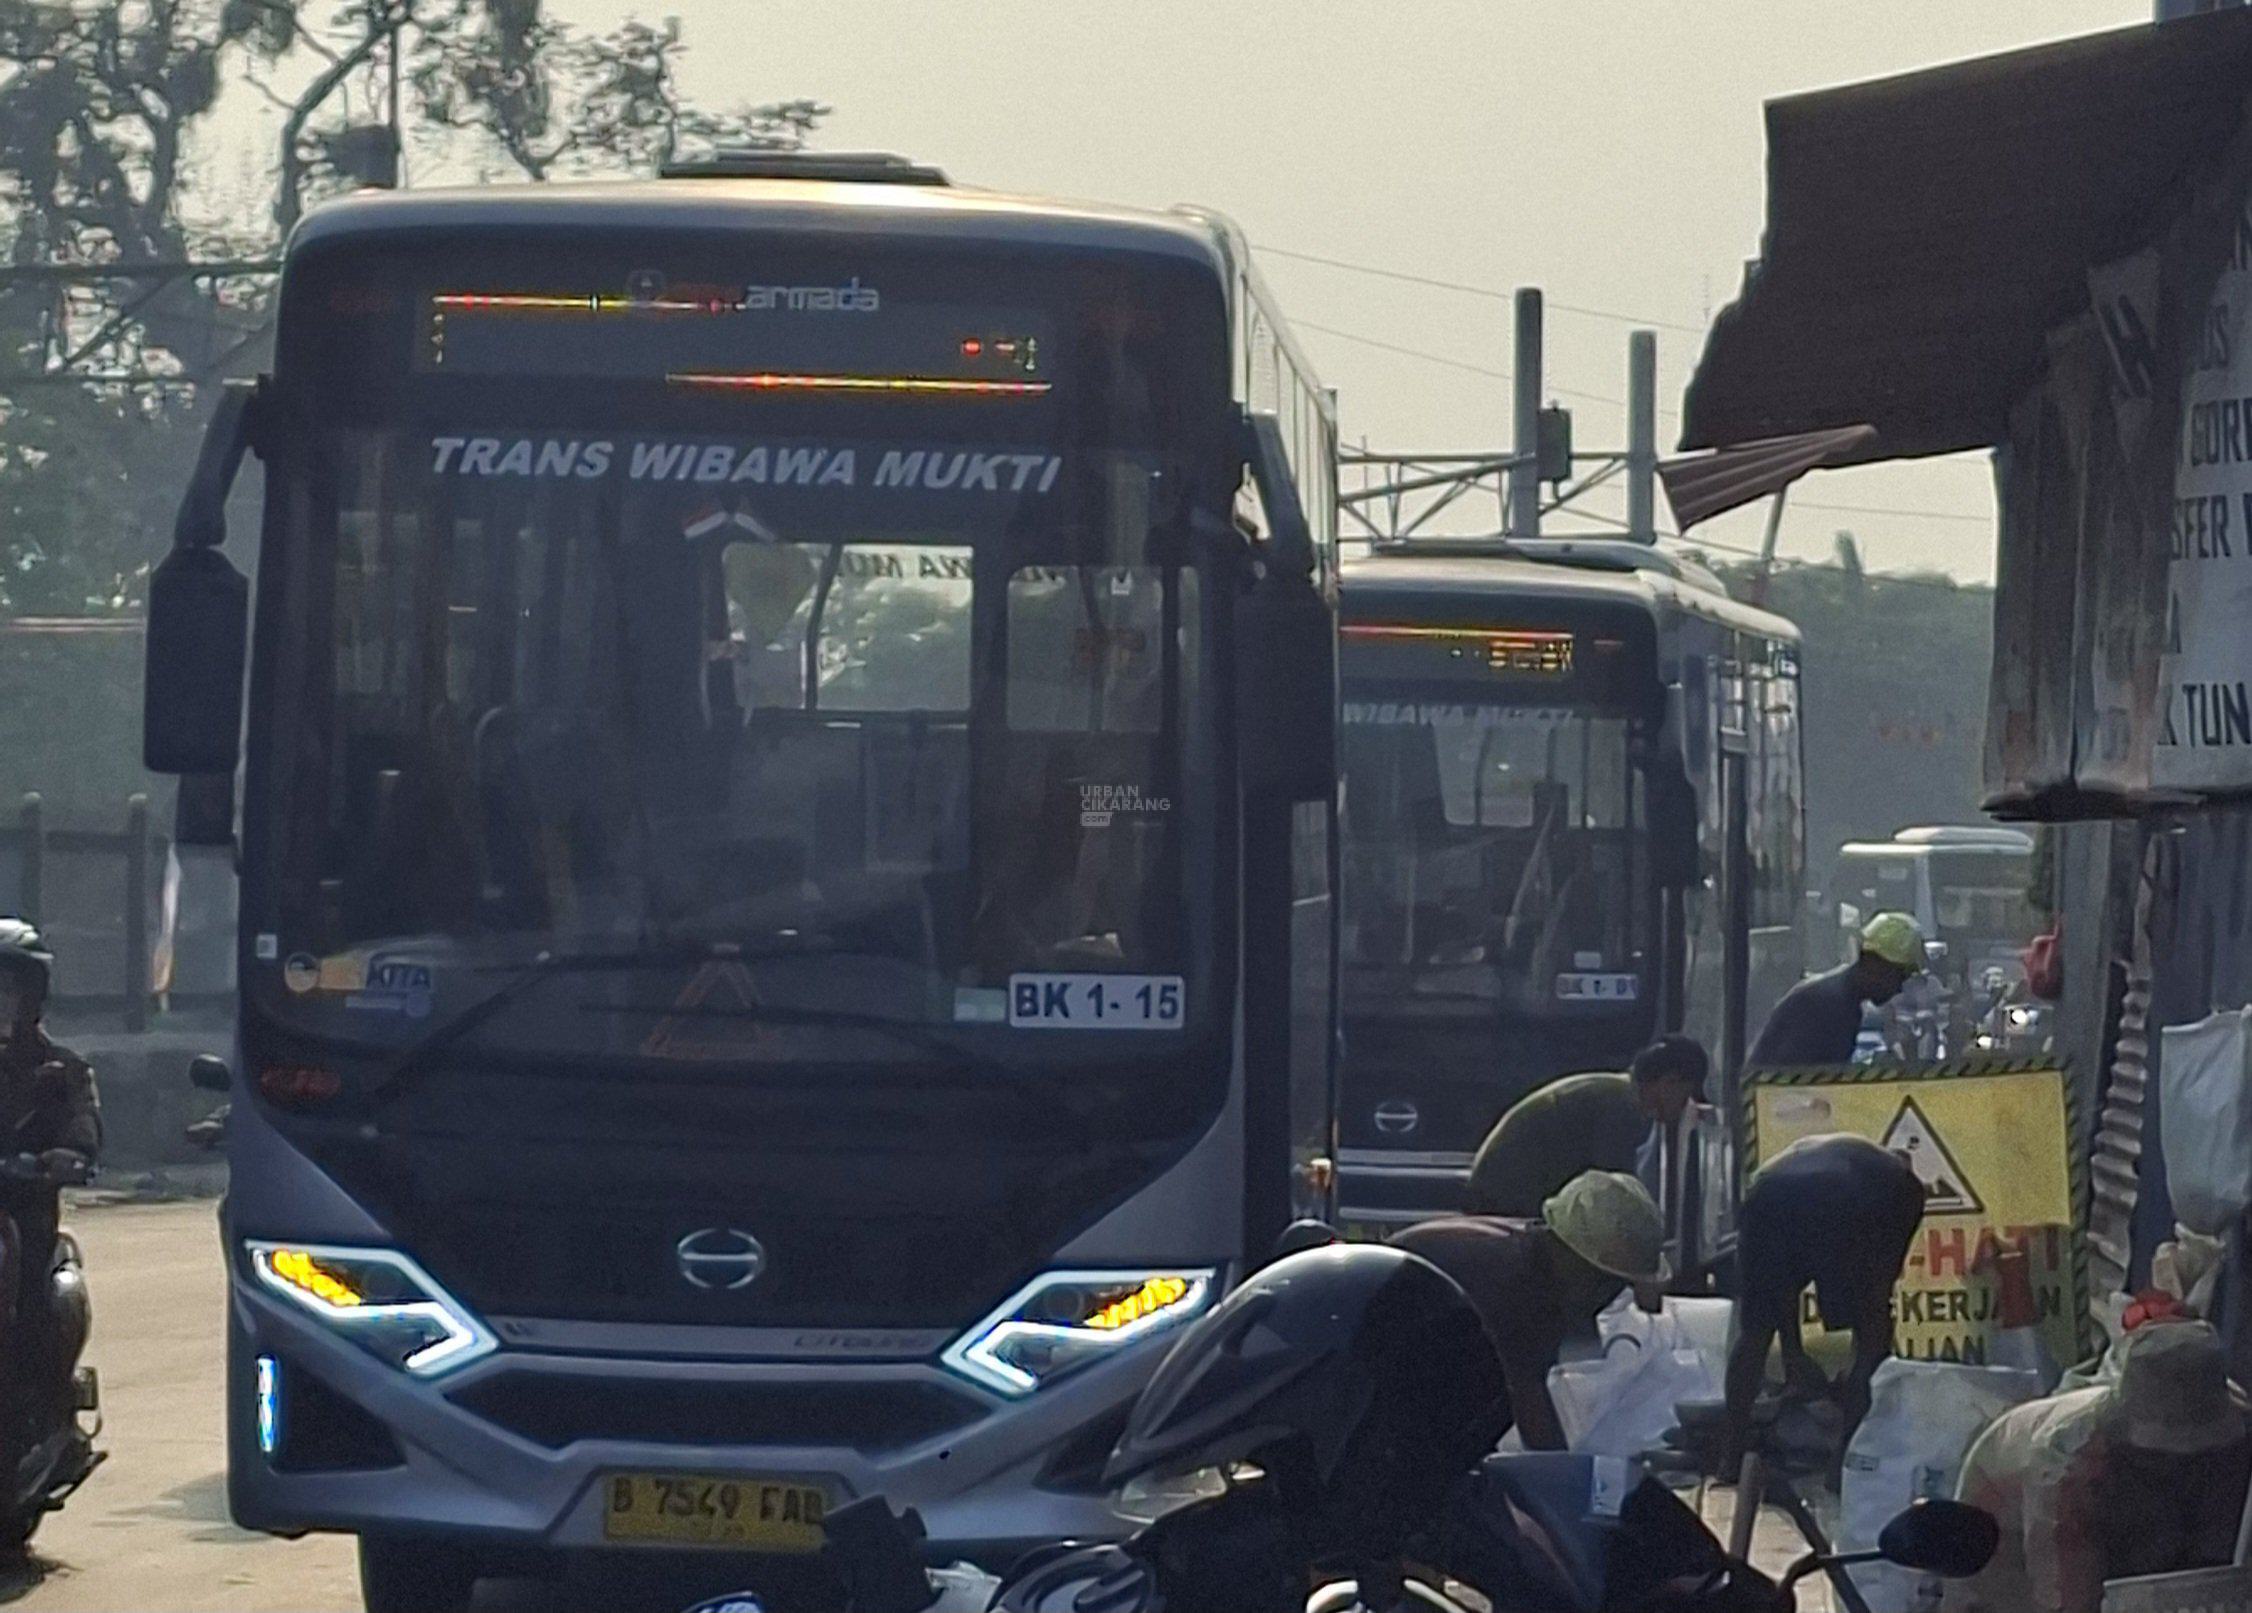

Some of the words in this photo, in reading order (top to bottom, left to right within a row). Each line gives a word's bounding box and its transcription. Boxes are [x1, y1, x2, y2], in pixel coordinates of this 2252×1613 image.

[744, 276, 880, 312] armada
[431, 437, 614, 480] TRANS
[628, 442, 856, 487] WIBAWA
[874, 450, 1063, 492] MUKTI
[1014, 981, 1072, 1019] BK
[613, 1475, 635, 1514] B
[654, 1477, 741, 1520] 7549
